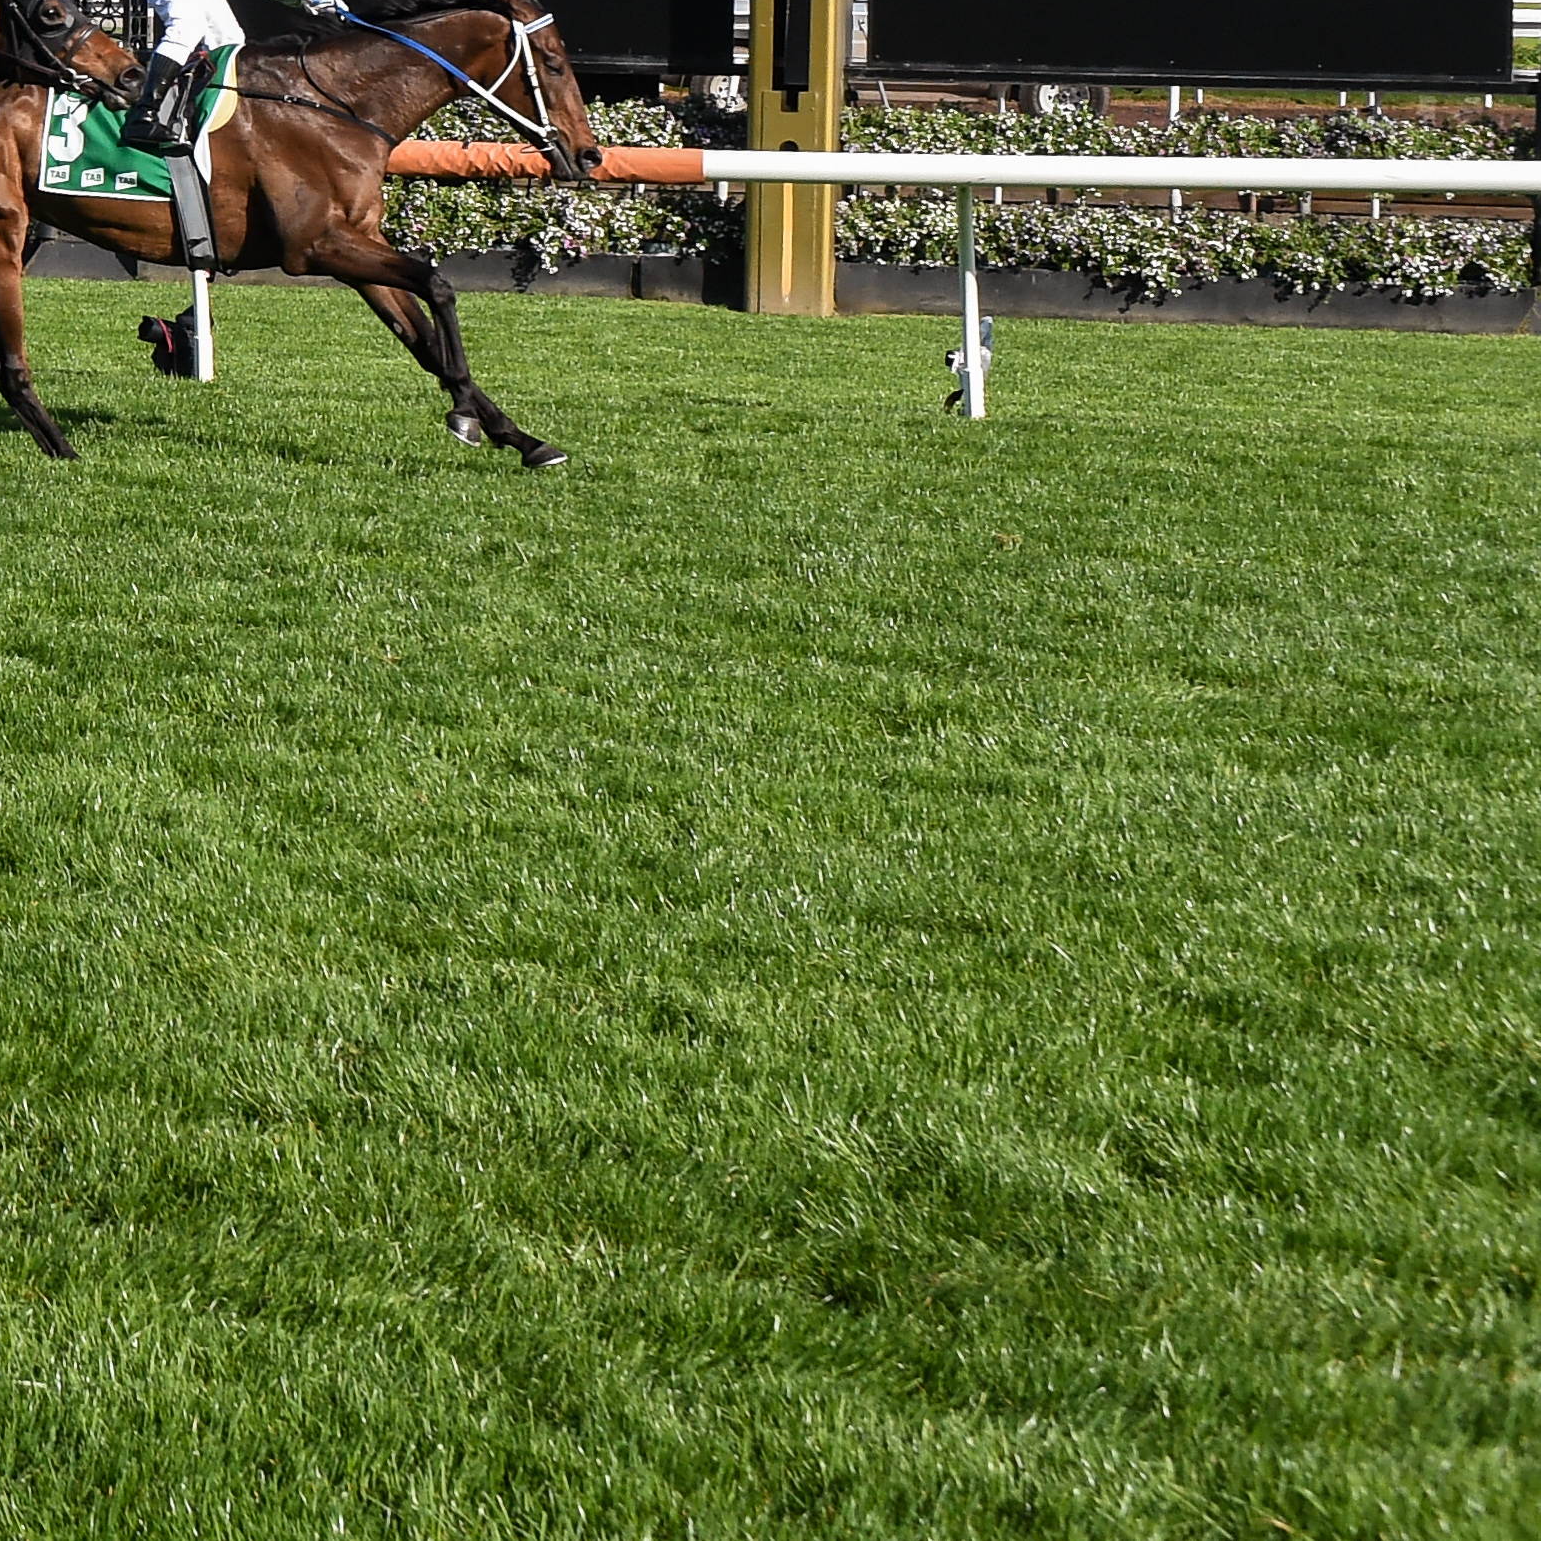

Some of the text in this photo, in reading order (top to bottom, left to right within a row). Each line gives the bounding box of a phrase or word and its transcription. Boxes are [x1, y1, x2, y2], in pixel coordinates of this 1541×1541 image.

[47, 93, 88, 163] 3
[50, 170, 67, 180] TAB
[85, 172, 101, 182] TAB
